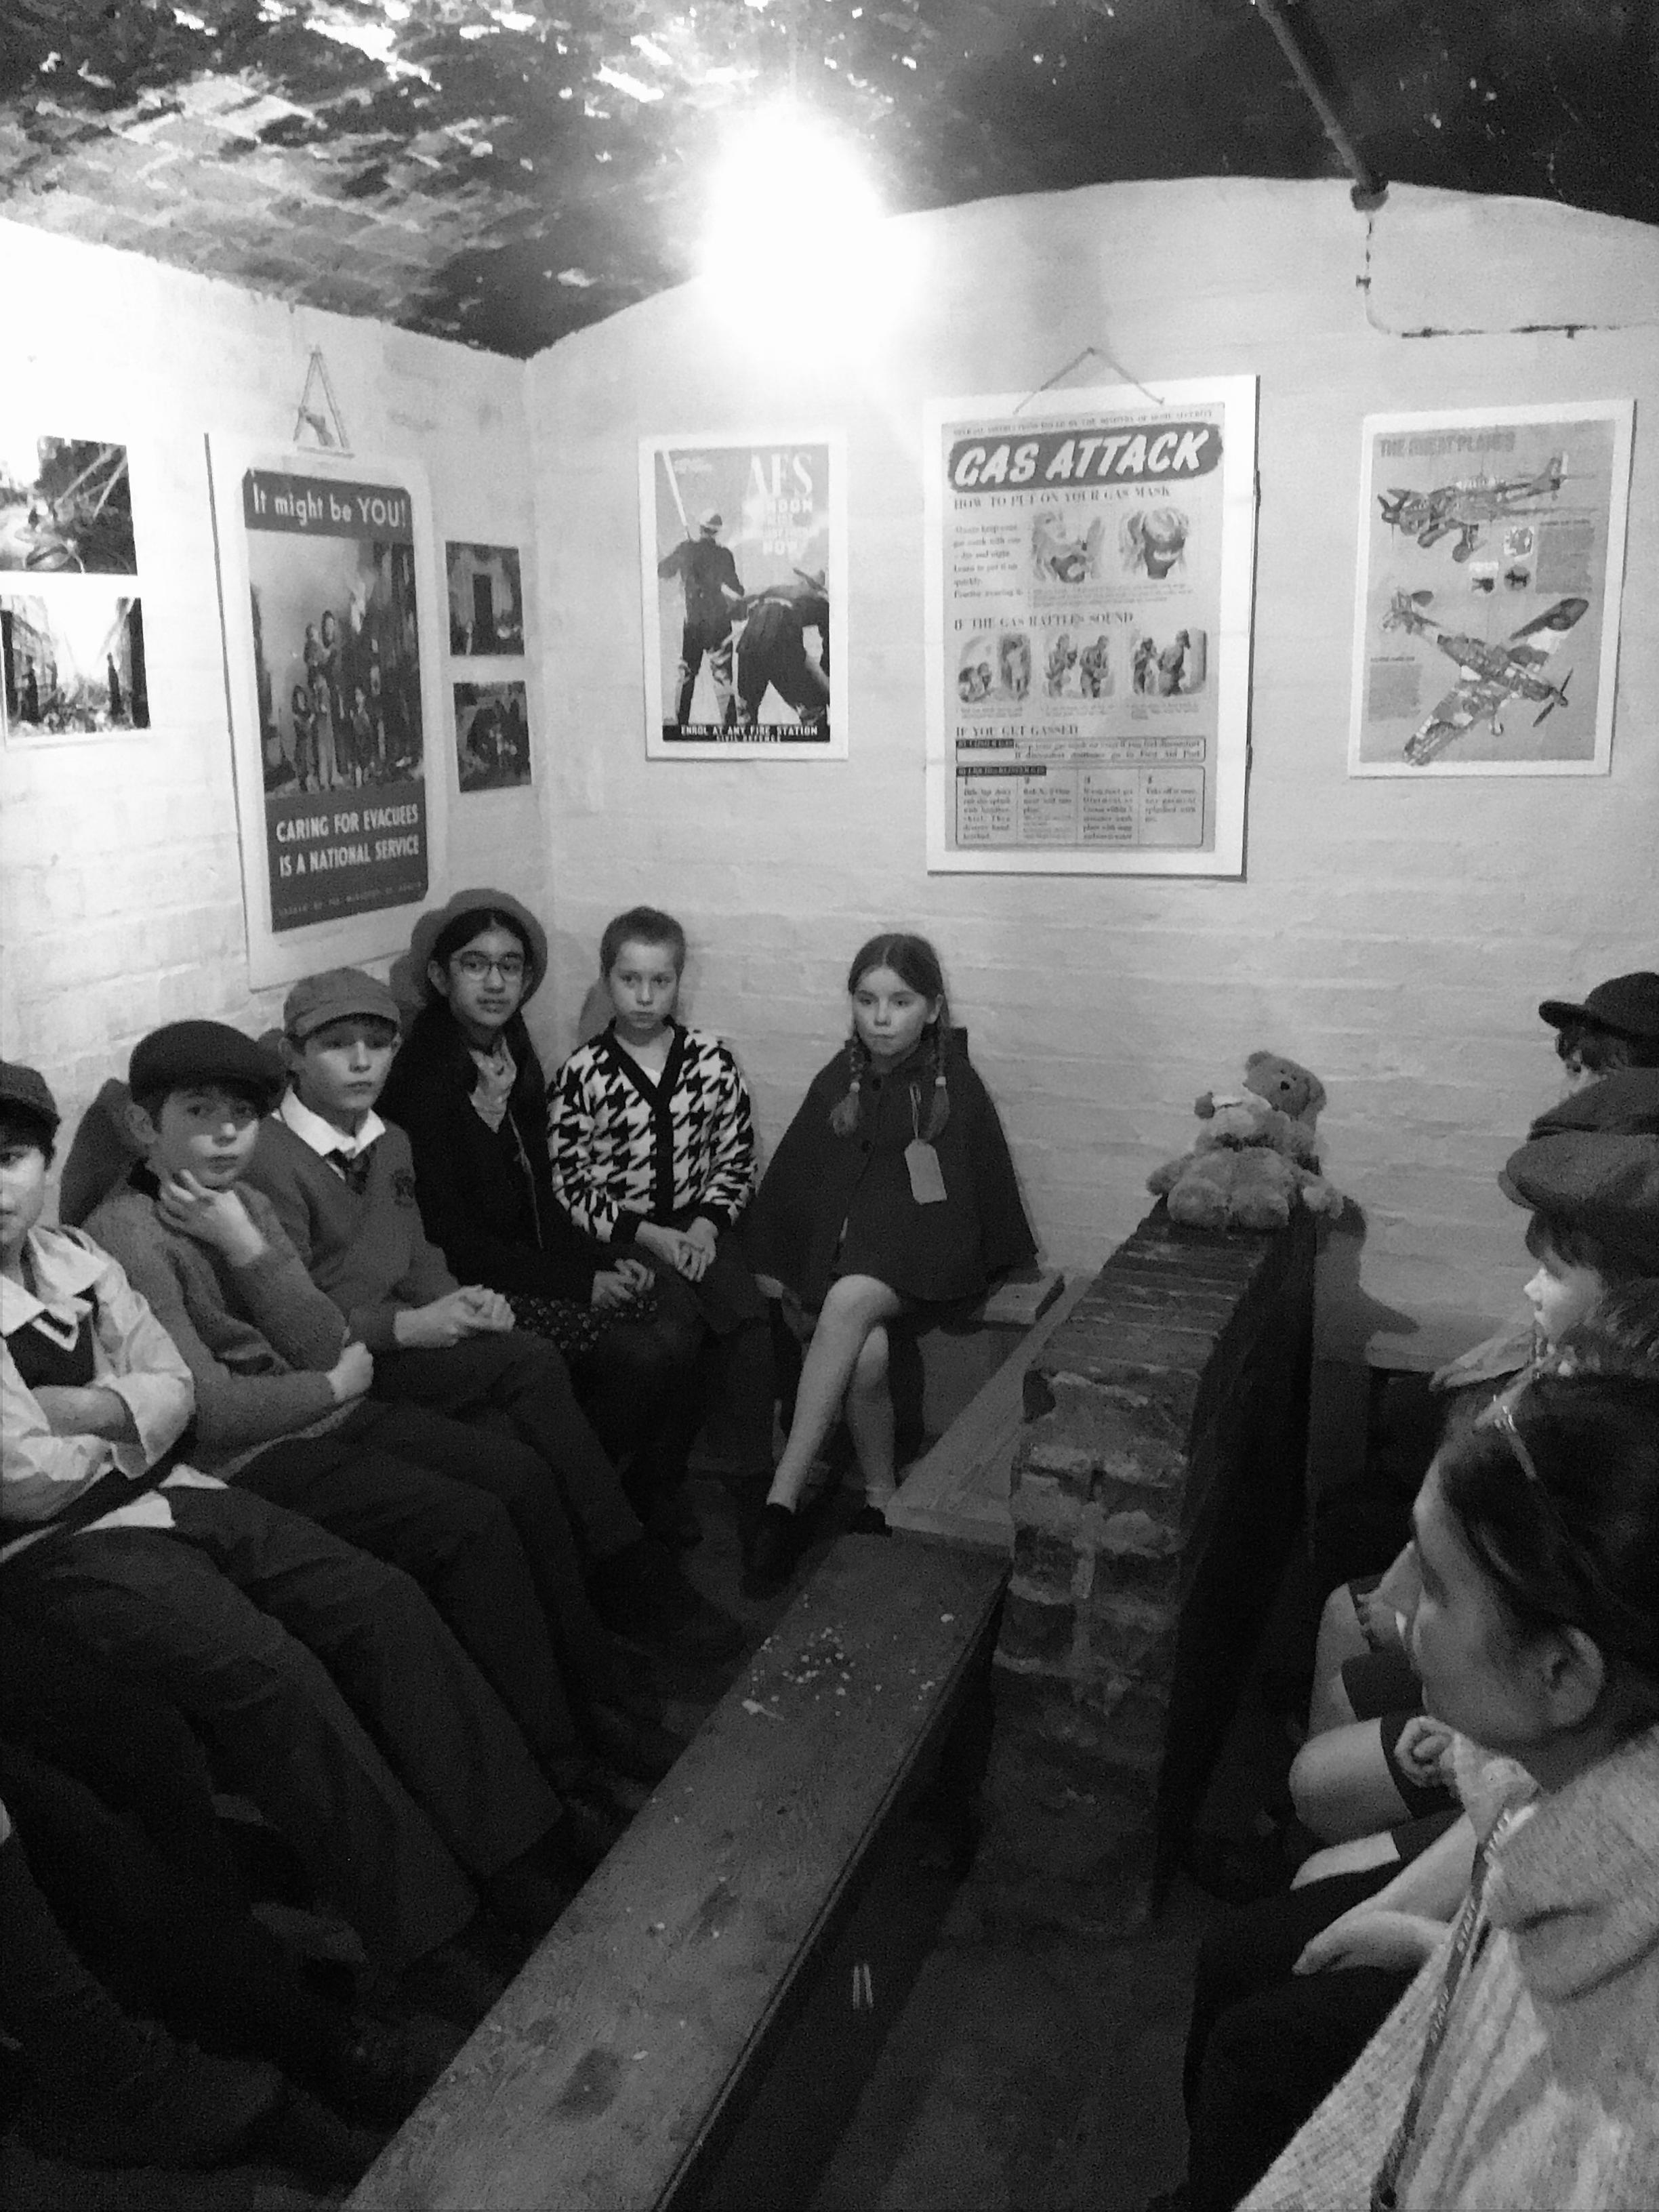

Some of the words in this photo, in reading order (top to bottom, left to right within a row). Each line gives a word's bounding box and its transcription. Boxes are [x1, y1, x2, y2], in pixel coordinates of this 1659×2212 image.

[746, 451, 813, 498] AFS
[954, 442, 1040, 487] GAS
[1045, 429, 1210, 480] ATTACK
[253, 482, 267, 514] It
[274, 489, 324, 527] might
[329, 493, 352, 523] be
[357, 496, 406, 528] YOU!
[954, 497, 981, 510] HOW
[991, 496, 1006, 508] TO
[1011, 495, 1034, 507] PUT
[1040, 493, 1059, 504] ON
[1065, 489, 1099, 504] YOUR
[1103, 488, 1130, 501] GAS
[1135, 486, 1170, 498] MASK
[680, 724, 708, 736] ENROL
[712, 724, 724, 735] AT
[727, 724, 746, 735] ANY
[750, 724, 771, 735] FIRE
[776, 724, 819, 736] STATION
[276, 815, 329, 843] CARING
[334, 811, 360, 834] FOR
[363, 803, 418, 832] EVACUEES
[279, 855, 292, 878] IS
[296, 853, 306, 874] A
[309, 842, 371, 873] NATIONAL
[375, 834, 419, 861] SERVICE
